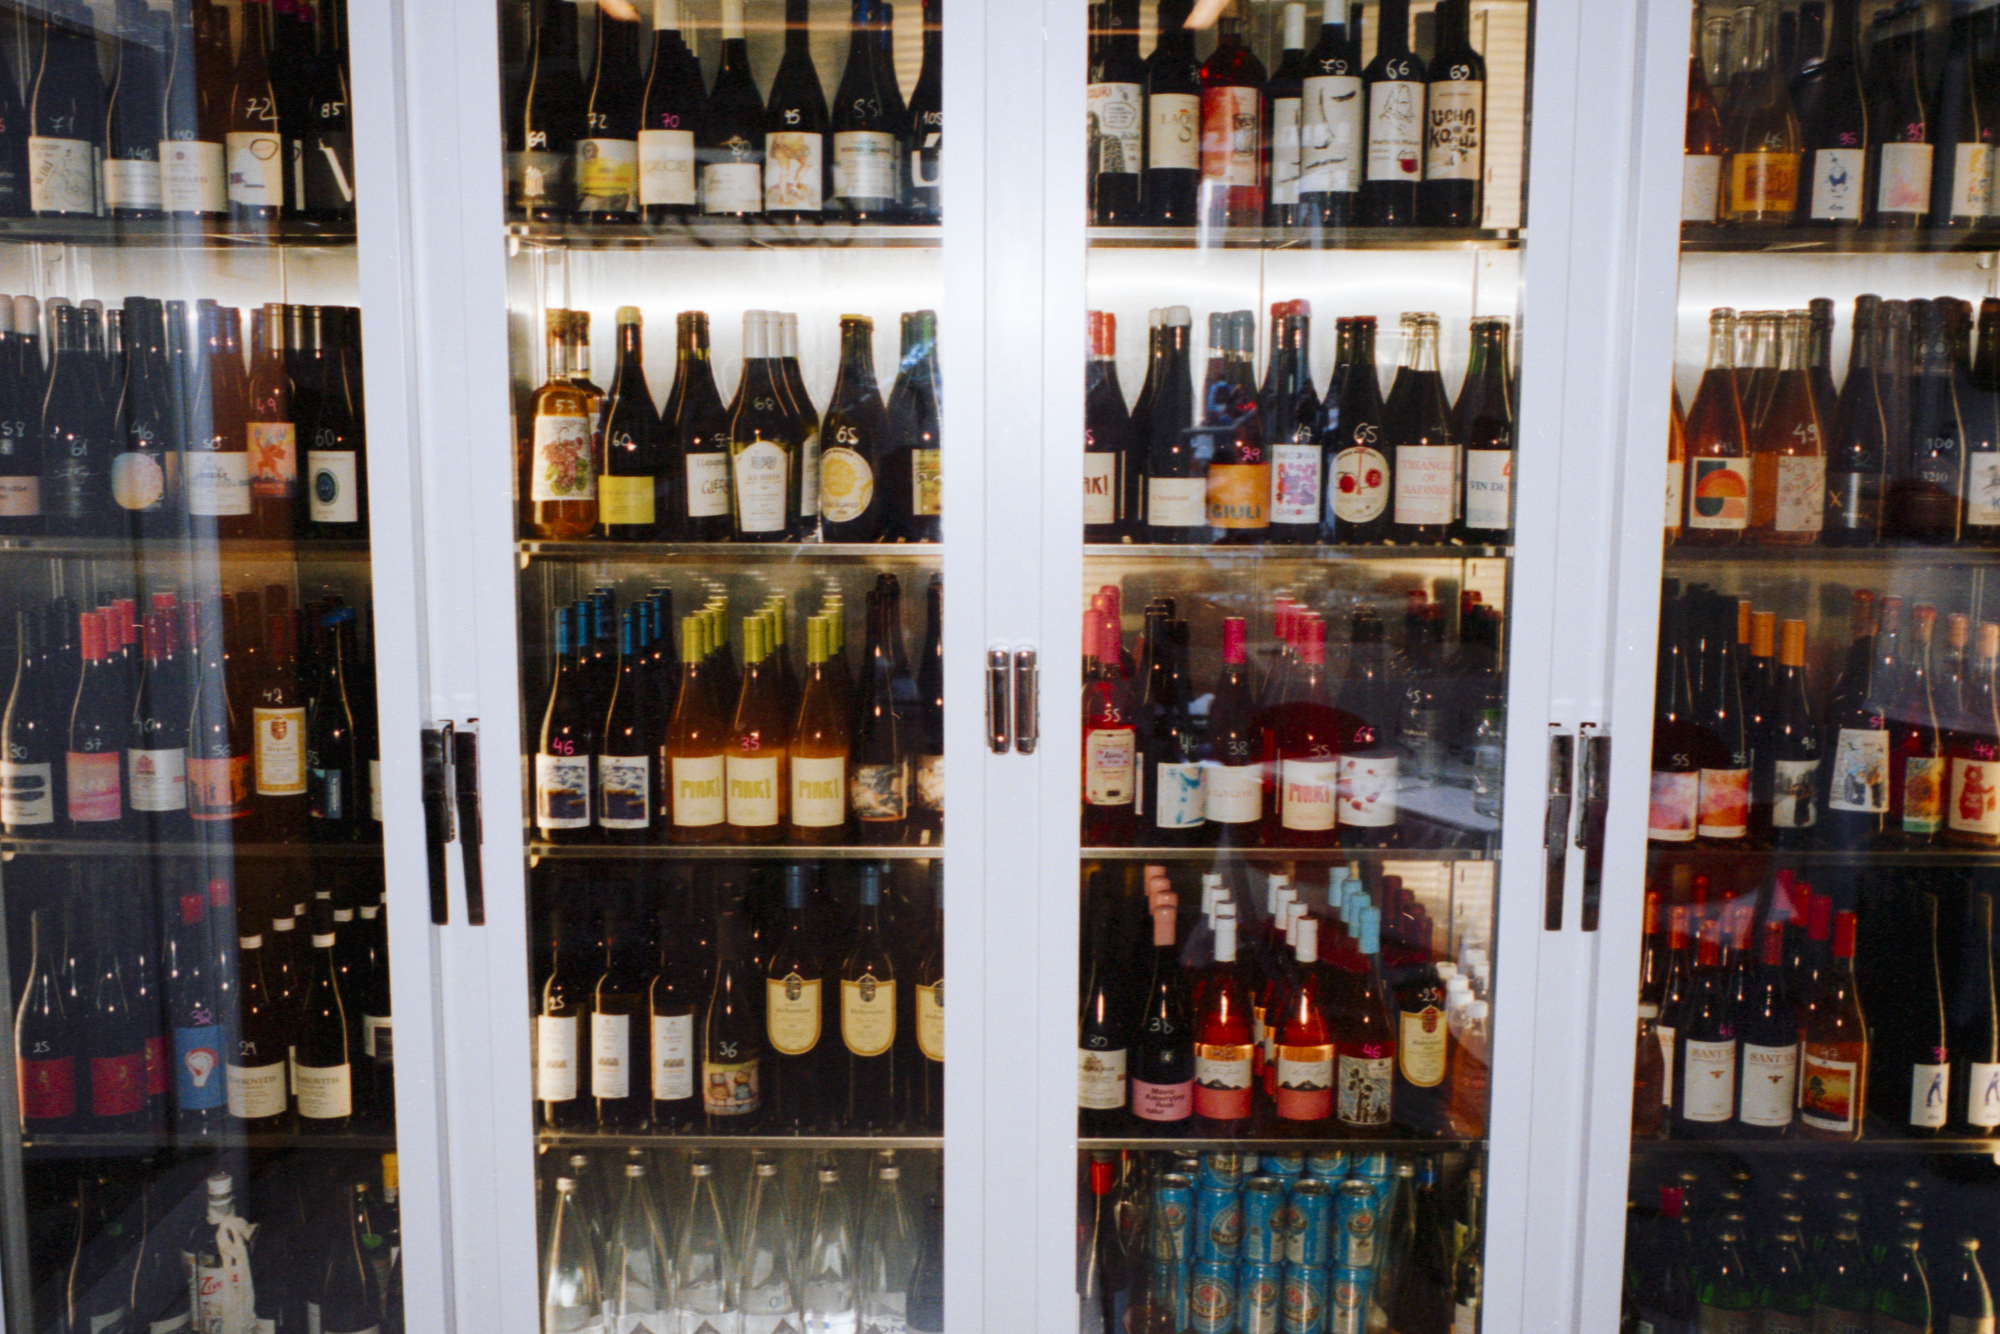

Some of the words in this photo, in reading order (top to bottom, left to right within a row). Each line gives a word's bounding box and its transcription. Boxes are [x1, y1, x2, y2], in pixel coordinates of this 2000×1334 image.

[1386, 59, 1409, 79] 66
[1450, 64, 1470, 80] 69
[246, 98, 279, 121] 72
[321, 103, 344, 118] 85
[587, 112, 608, 129] 72
[661, 113, 680, 128] 70
[552, 736, 574, 755] 46
[1228, 741, 1248, 755] 38
[719, 1041, 738, 1058] 36
